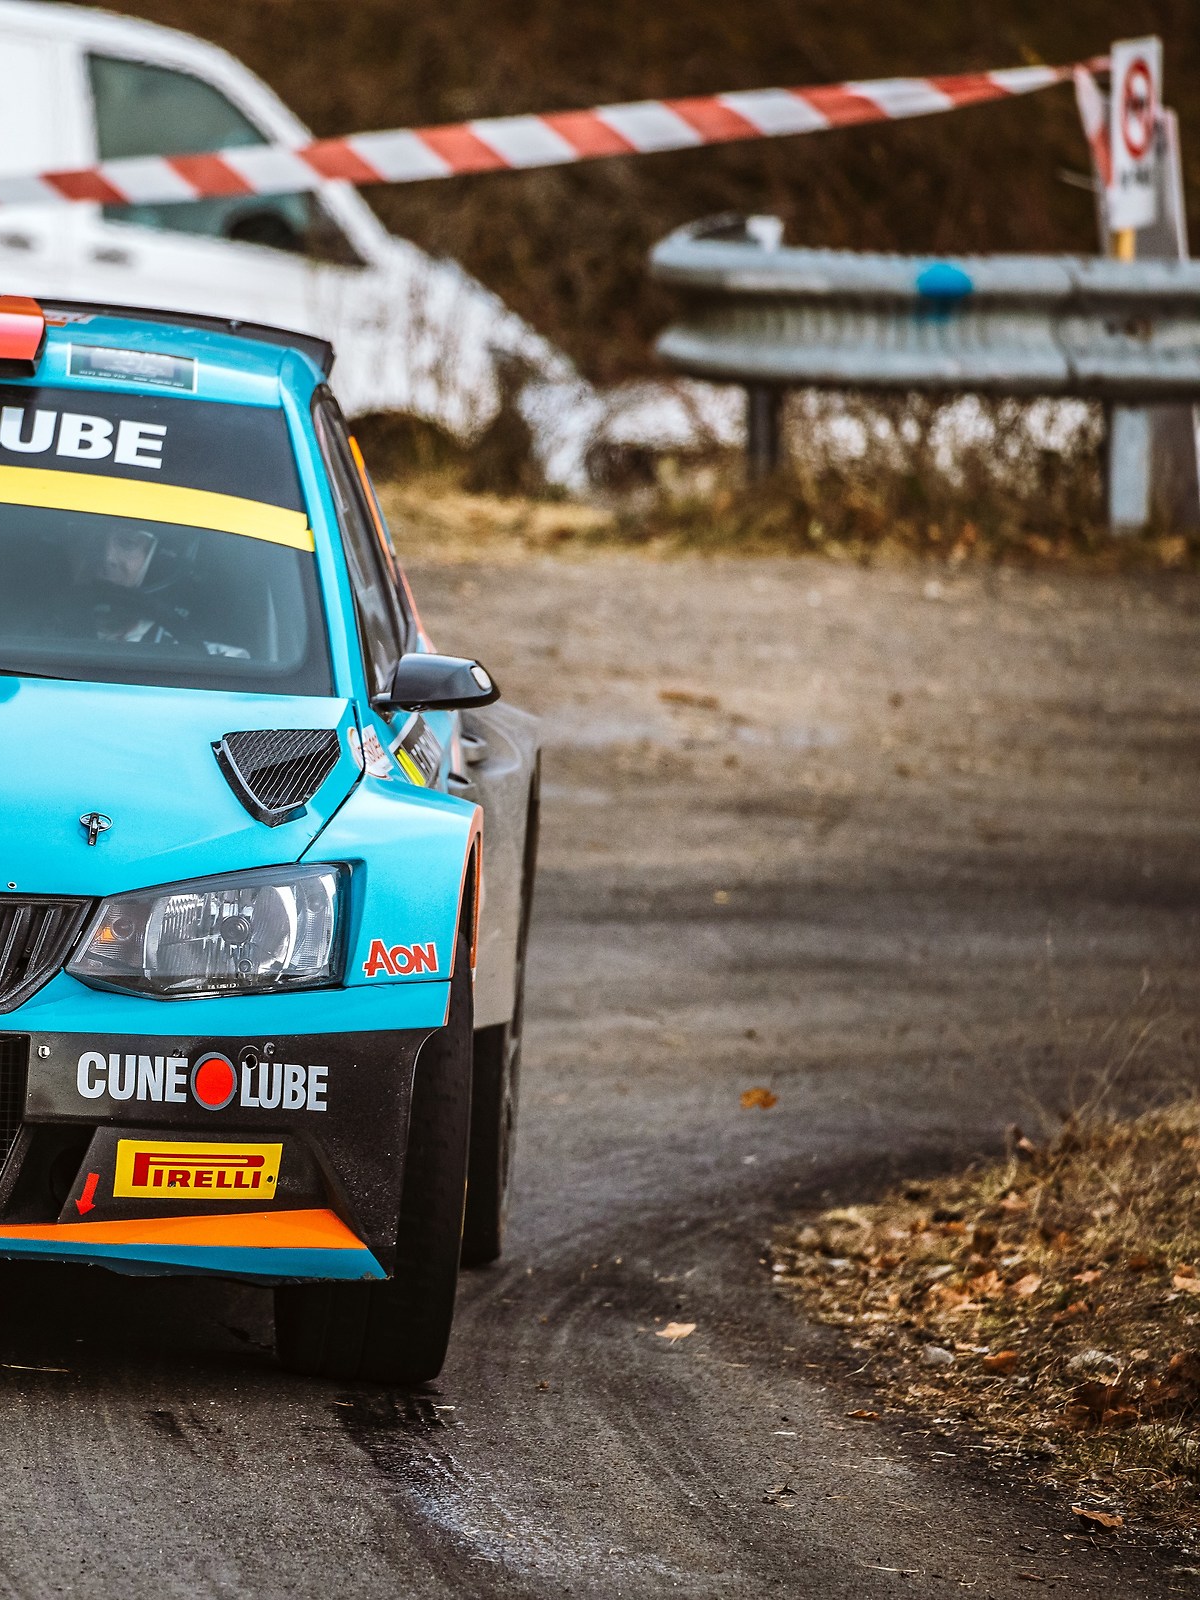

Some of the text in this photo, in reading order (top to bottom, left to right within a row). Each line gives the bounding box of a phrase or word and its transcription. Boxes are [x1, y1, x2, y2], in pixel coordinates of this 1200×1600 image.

[362, 939, 438, 976] AON
[76, 1051, 329, 1111] CUNE LUBE
[132, 1152, 266, 1190] PIRELLI
